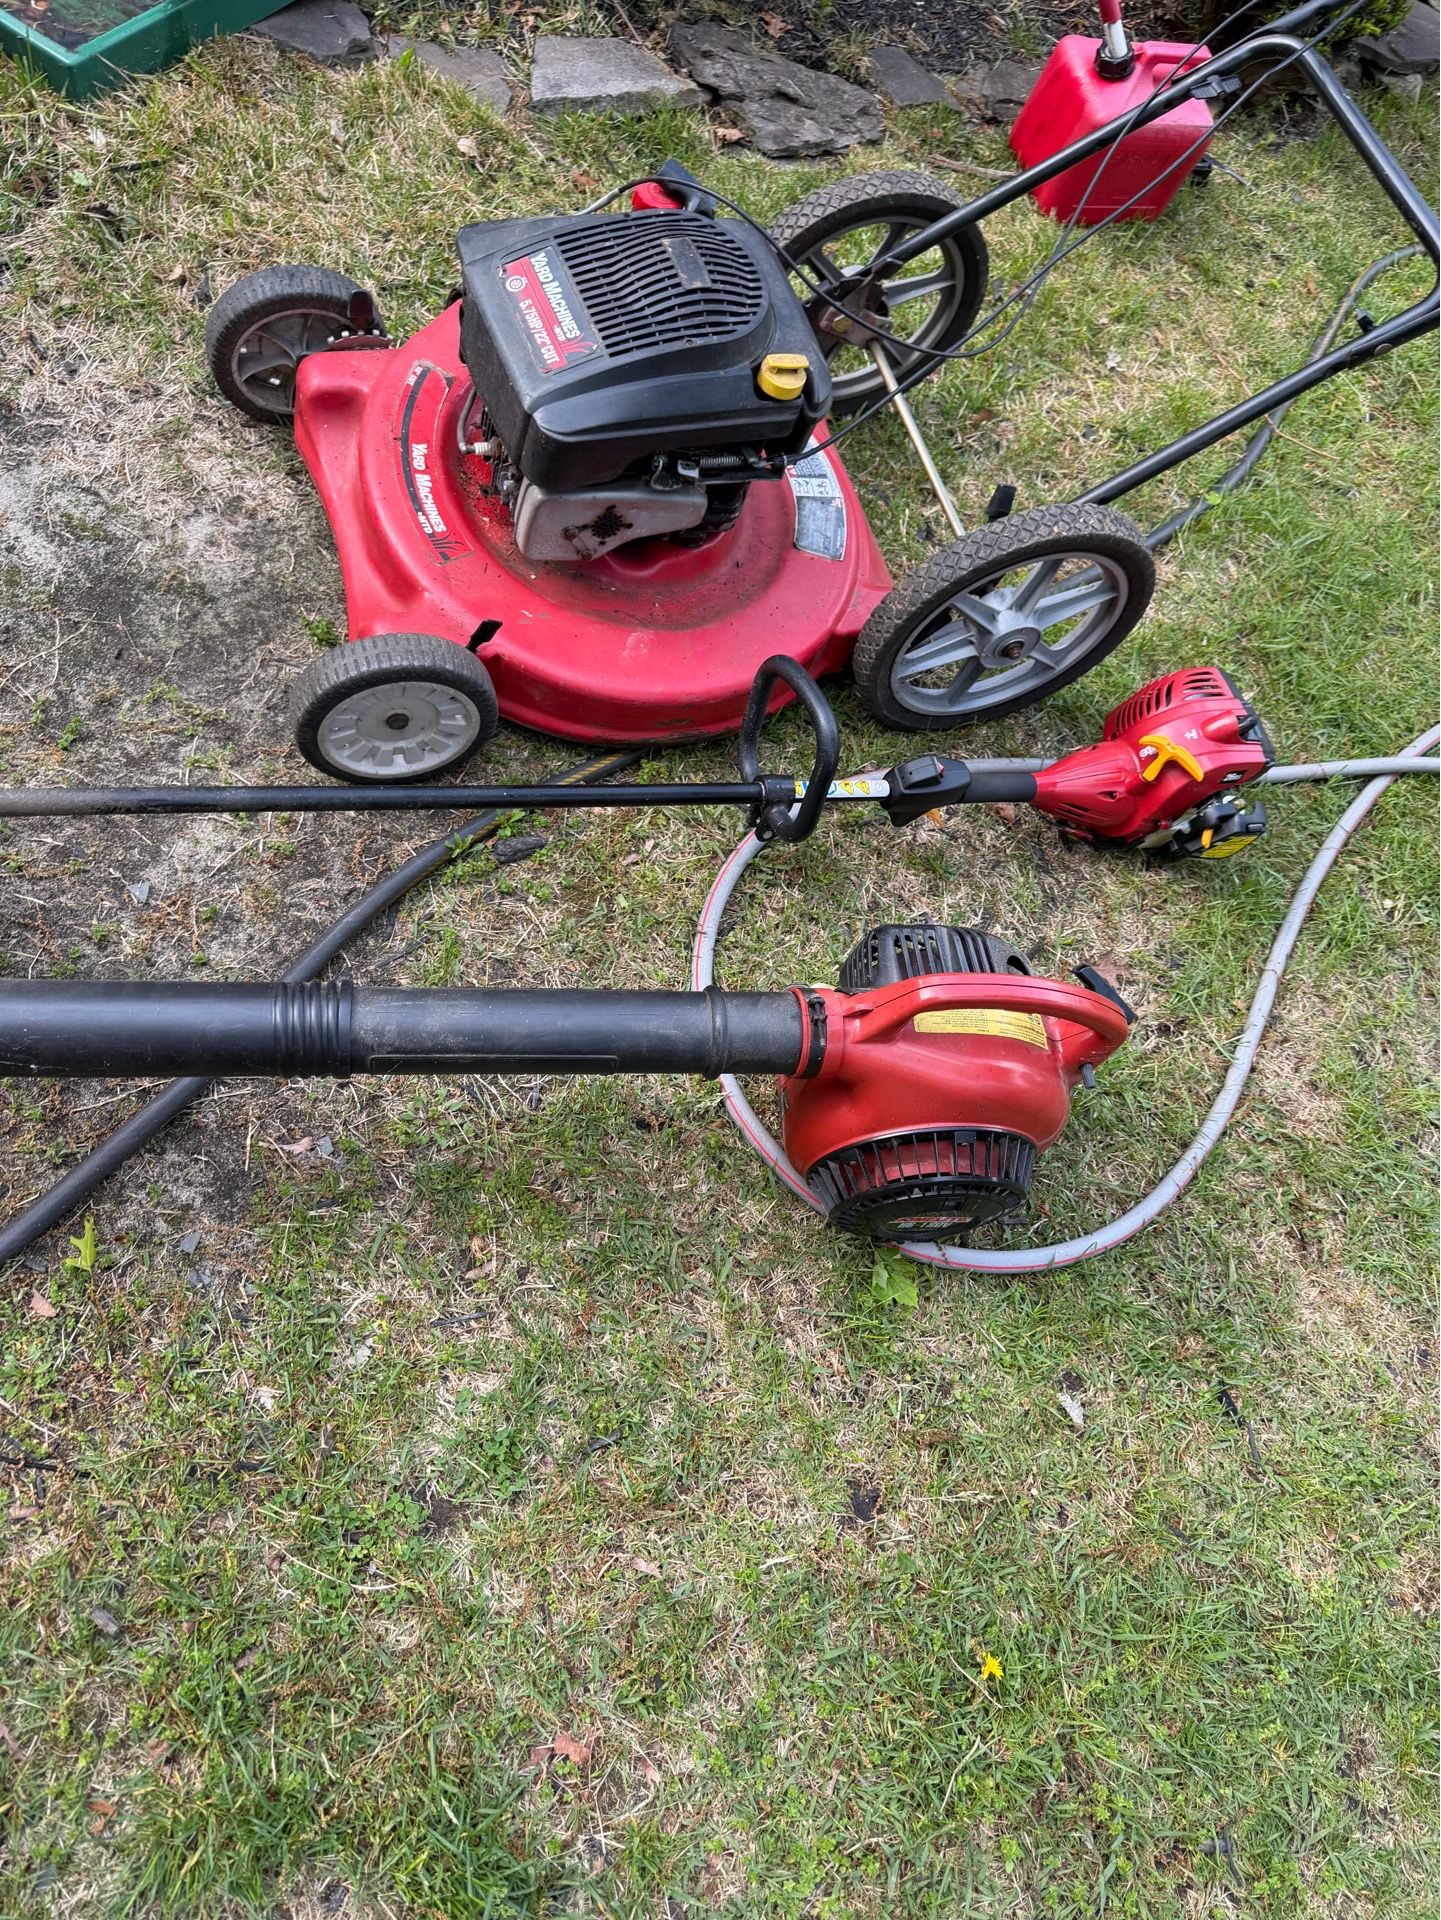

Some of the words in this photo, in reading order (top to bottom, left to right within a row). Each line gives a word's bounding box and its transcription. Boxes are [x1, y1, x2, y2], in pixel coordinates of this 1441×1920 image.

[530, 252, 553, 283] YARD
[543, 281, 581, 339] MACHINES
[412, 443, 428, 471] YARD
[415, 473, 447, 533] MACHINES
[418, 513, 433, 534] MTD
